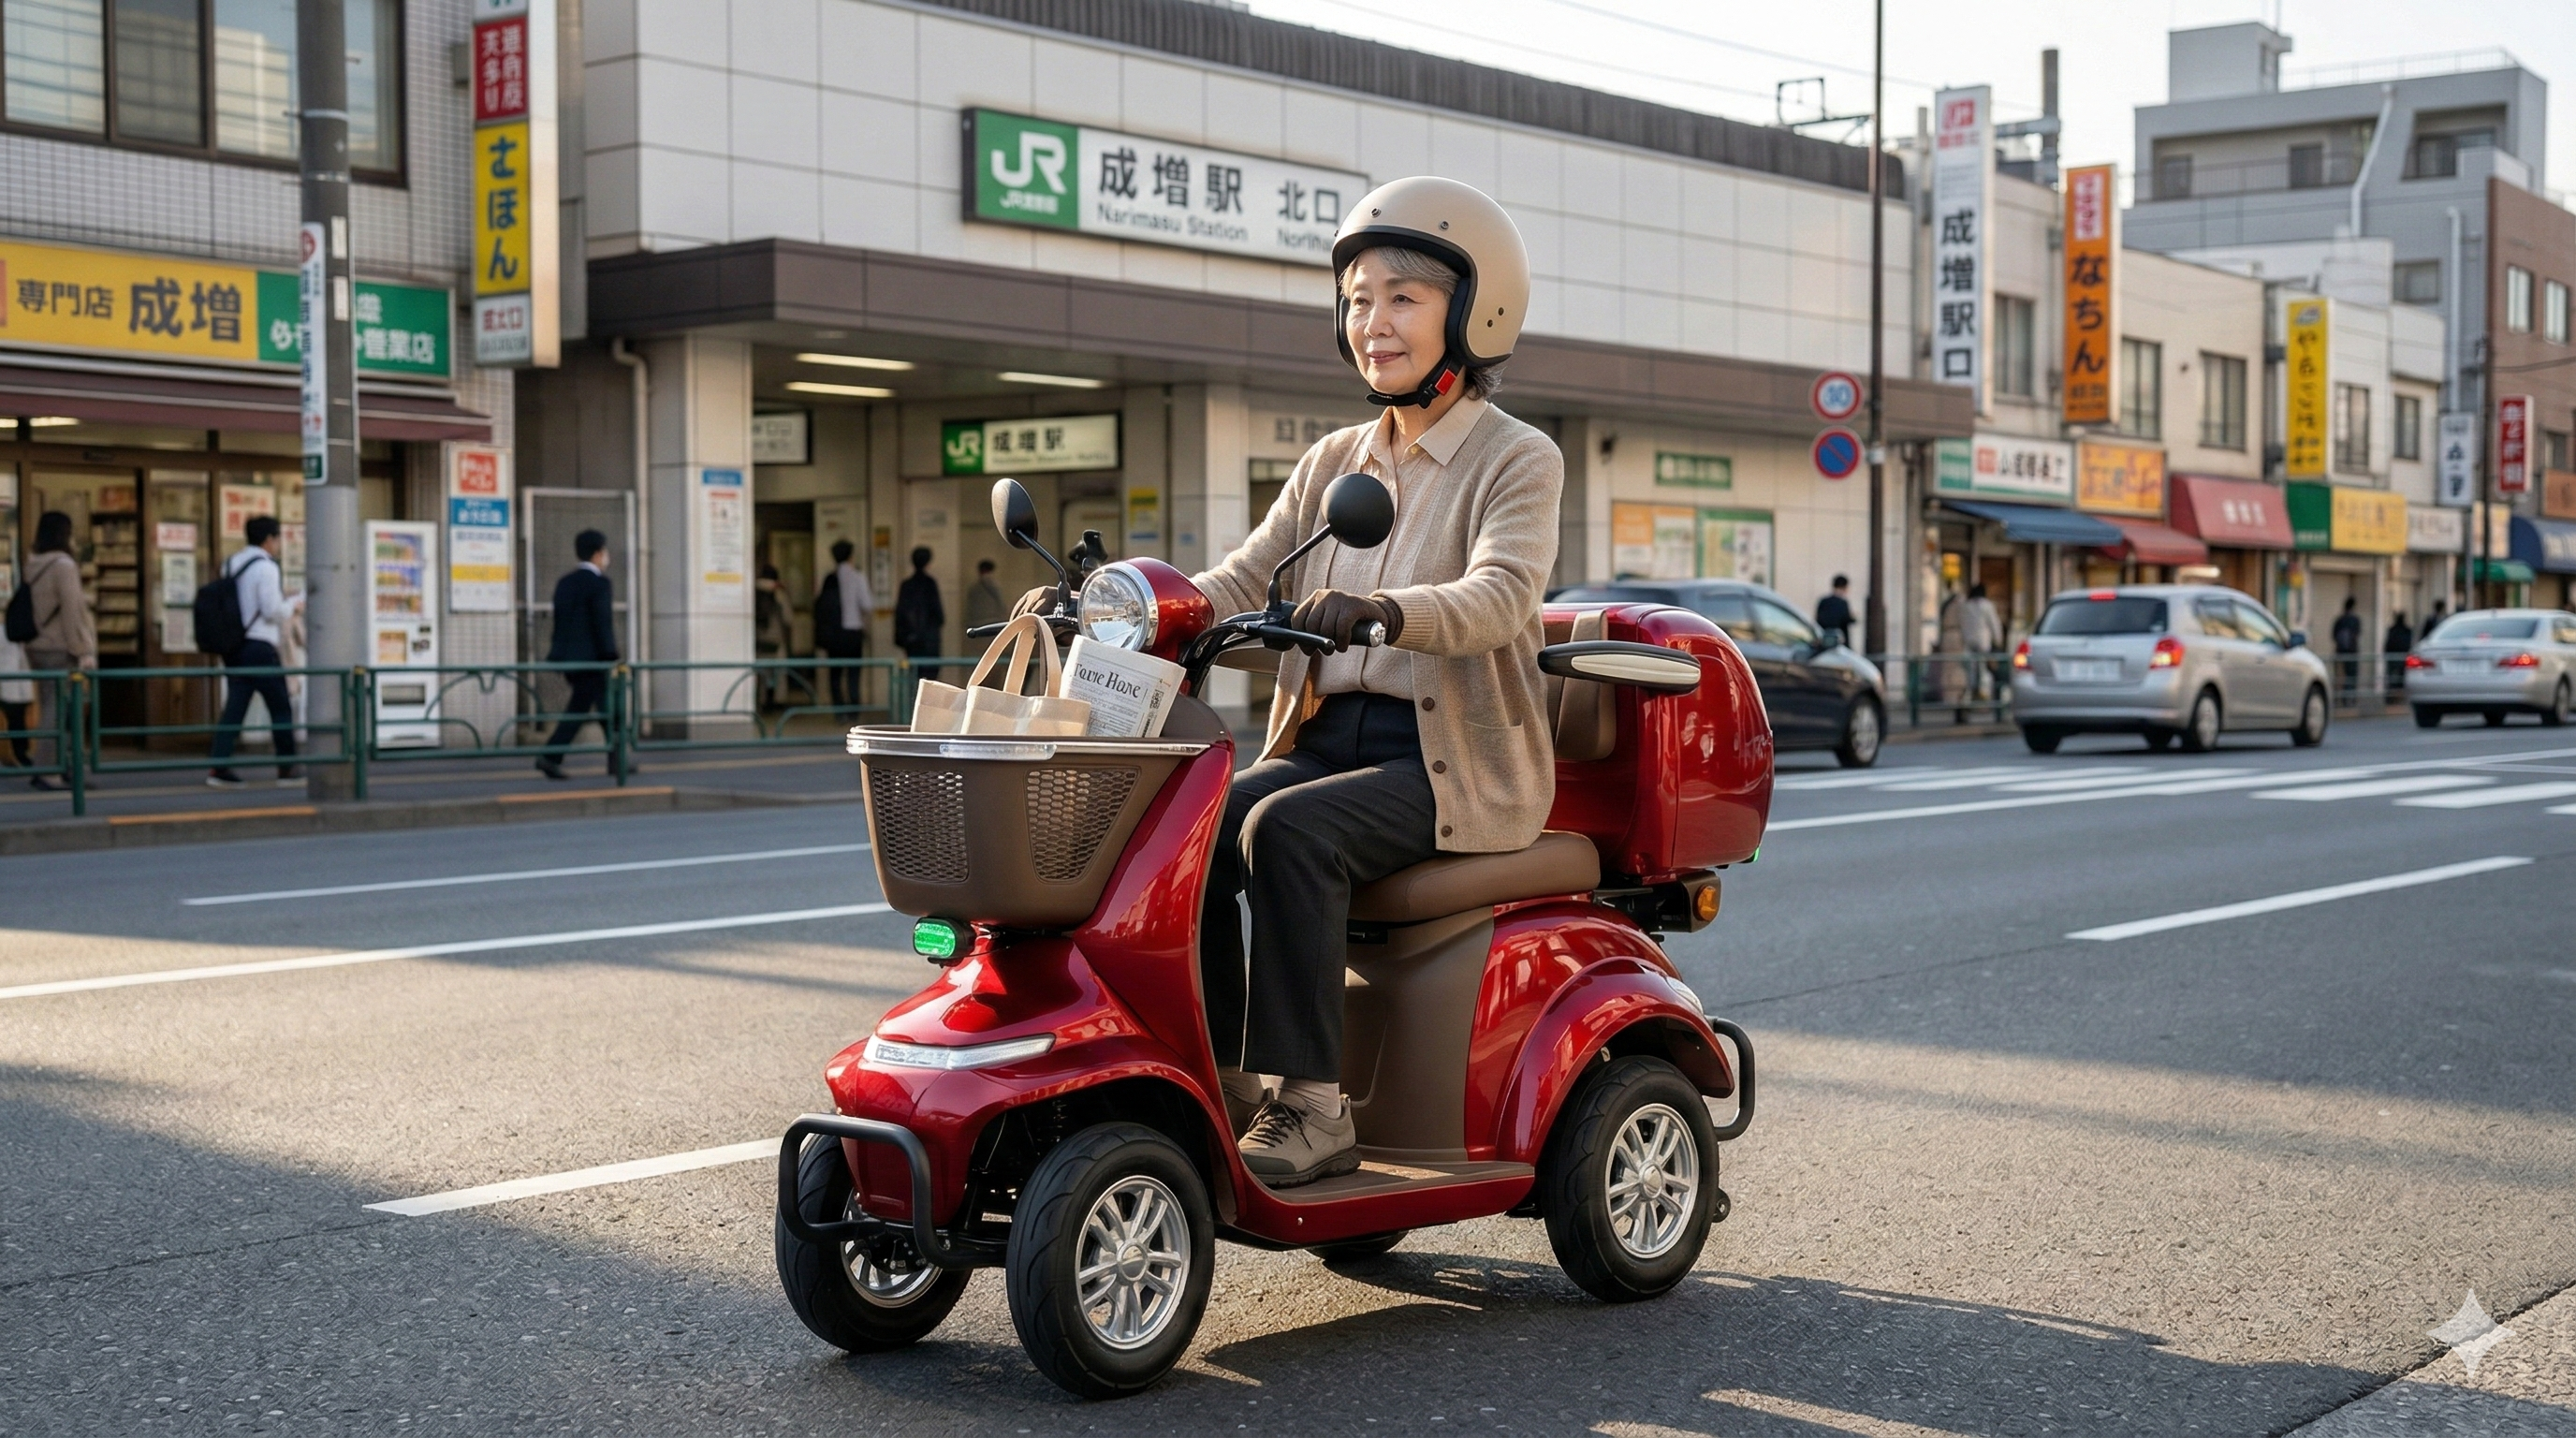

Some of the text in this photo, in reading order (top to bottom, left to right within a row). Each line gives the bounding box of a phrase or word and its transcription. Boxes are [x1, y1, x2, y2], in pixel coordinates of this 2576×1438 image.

[990, 131, 1067, 195] JR
[1099, 146, 1243, 214] 成増駅
[1277, 179, 1340, 226] 北口
[1097, 202, 1182, 233] Narimasu
[1187, 214, 1250, 242] Station
[16, 278, 114, 320] 専門店
[128, 276, 242, 344] 成増
[1940, 207, 1976, 379] 成増駅口
[945, 431, 981, 458] JR
